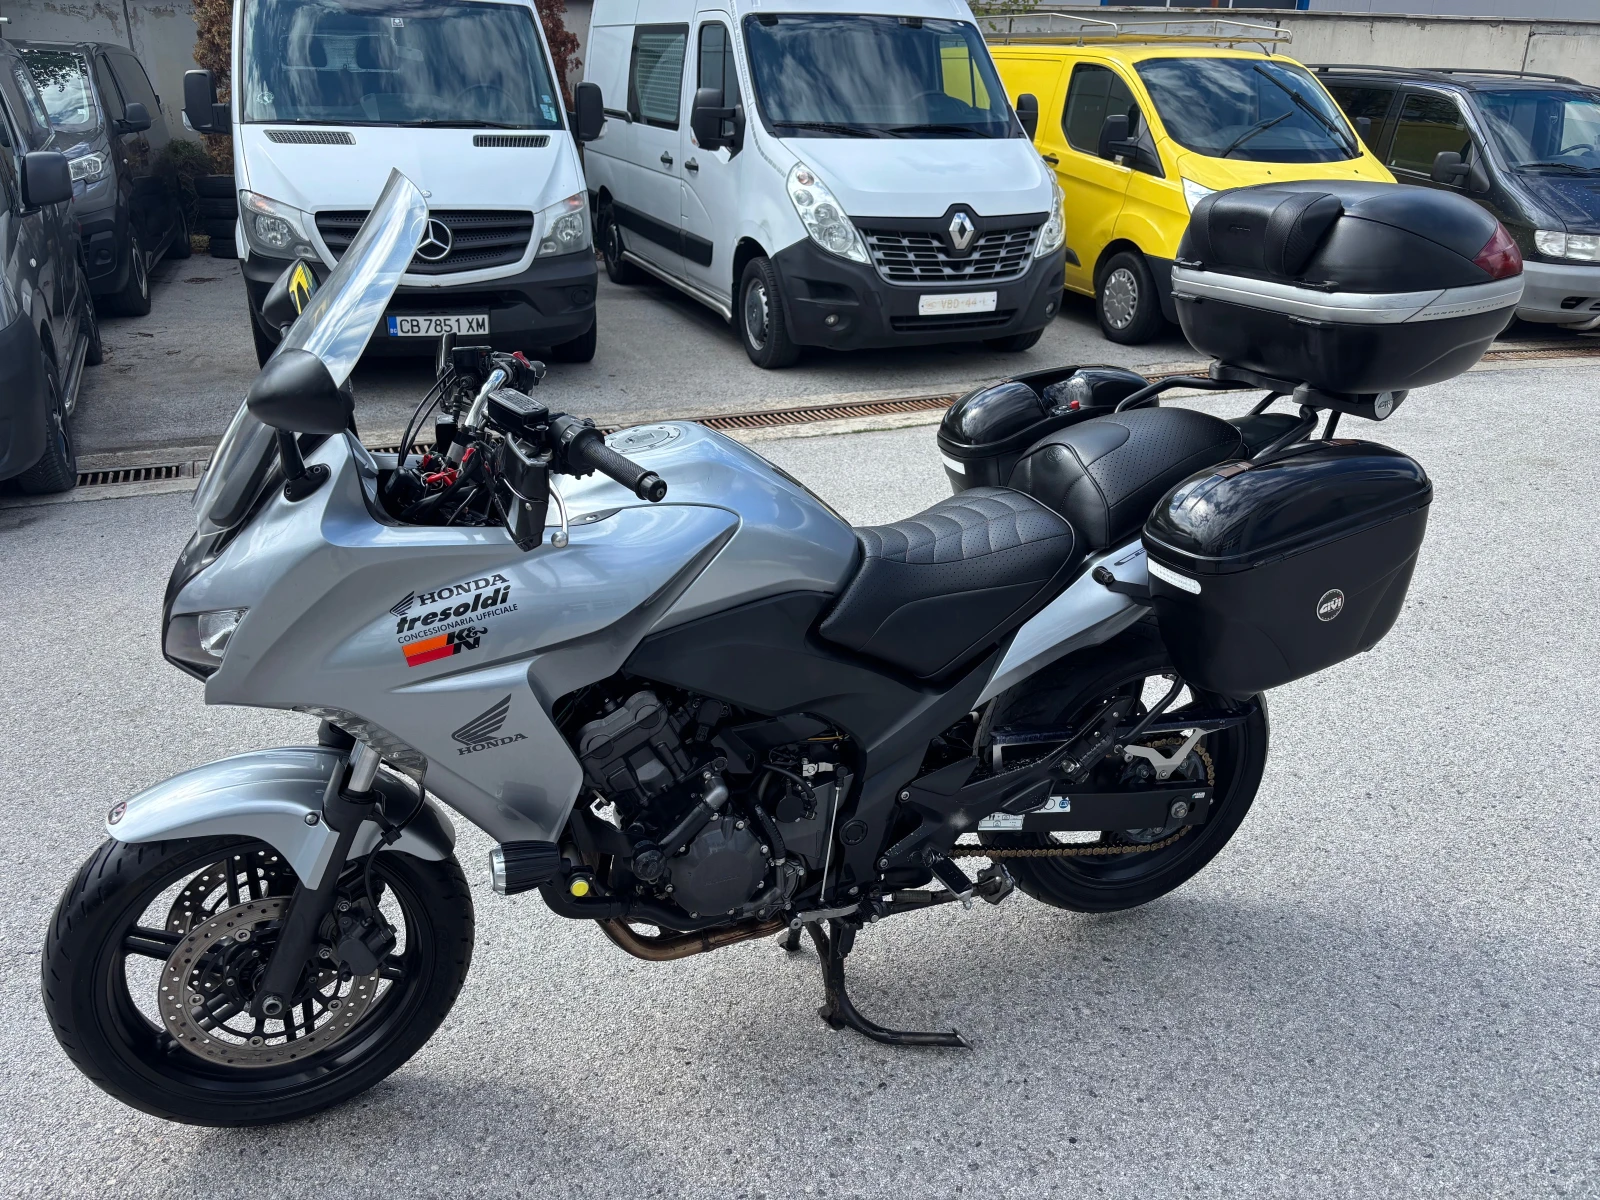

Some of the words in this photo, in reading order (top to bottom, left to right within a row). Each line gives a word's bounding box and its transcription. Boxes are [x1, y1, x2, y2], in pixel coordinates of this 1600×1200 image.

[399, 318, 421, 334] CB
[423, 317, 461, 334] 7851
[465, 316, 486, 333] XM
[417, 573, 510, 607] HONDA
[396, 585, 511, 634] tresoldi
[397, 616, 475, 644] CONCESSIONARIA
[476, 603, 519, 621] UFFICIALE
[446, 625, 489, 655] K&N
[456, 732, 529, 756] HONDA
